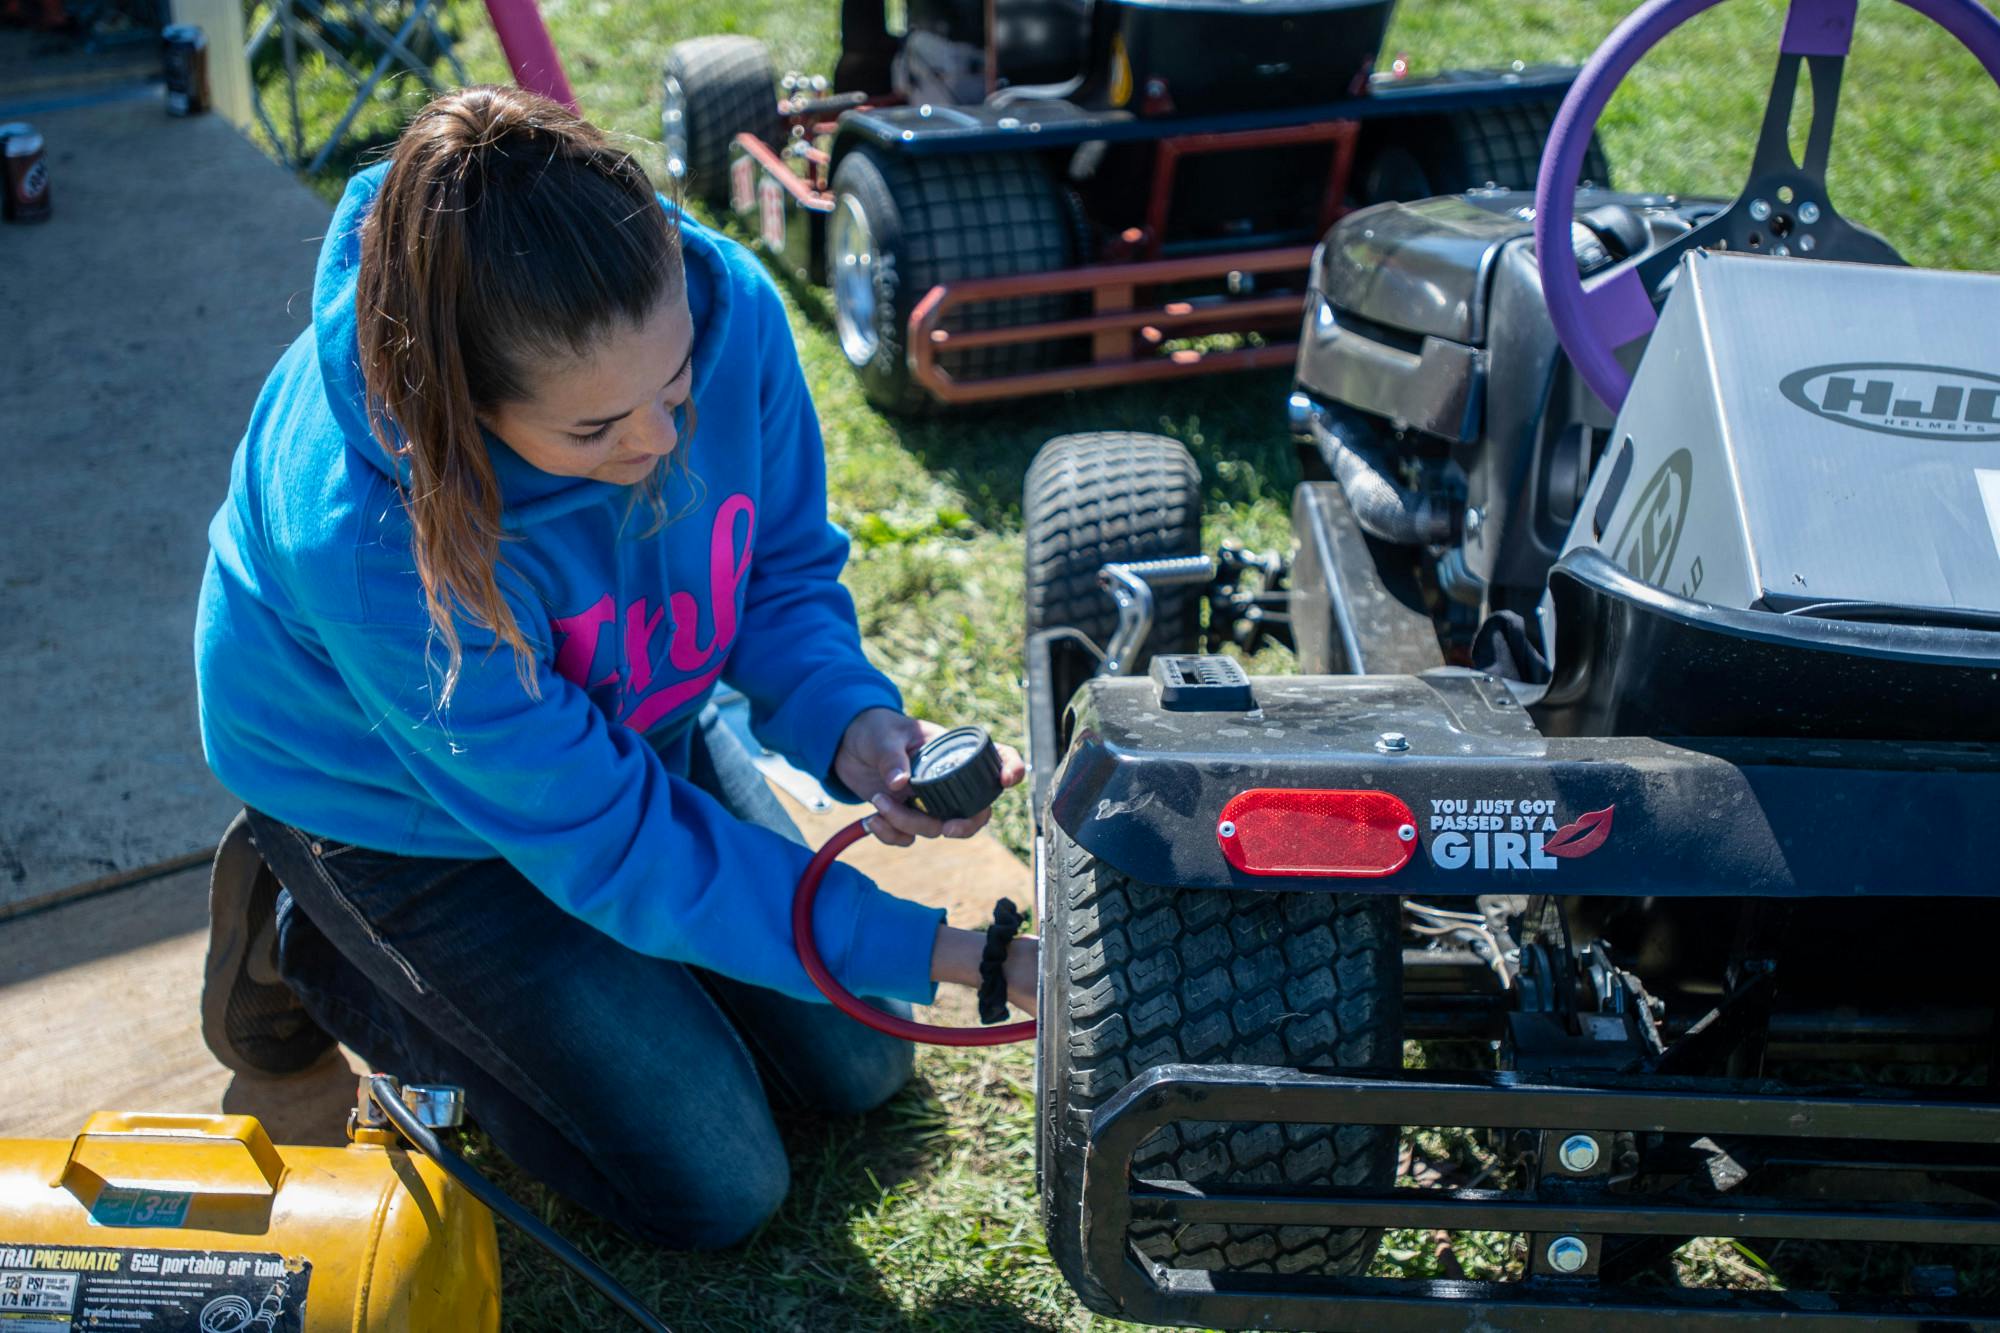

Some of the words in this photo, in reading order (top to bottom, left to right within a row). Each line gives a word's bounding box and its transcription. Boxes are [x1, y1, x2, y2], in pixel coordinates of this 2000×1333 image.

[1884, 418, 1985, 433] HELMETS
[1430, 800, 1467, 814] YOU
[1473, 800, 1514, 814] JUST
[1519, 800, 1556, 814] GOT
[1430, 816, 1504, 831] PASSED
[1511, 816, 1537, 831] BY
[1542, 816, 1557, 831] A
[1431, 832, 1558, 869] GIRL
[160, 1255, 224, 1275] portable
[227, 1258, 251, 1275] air
[26, 1276, 44, 1290] PSI
[21, 1293, 42, 1307] NPT
